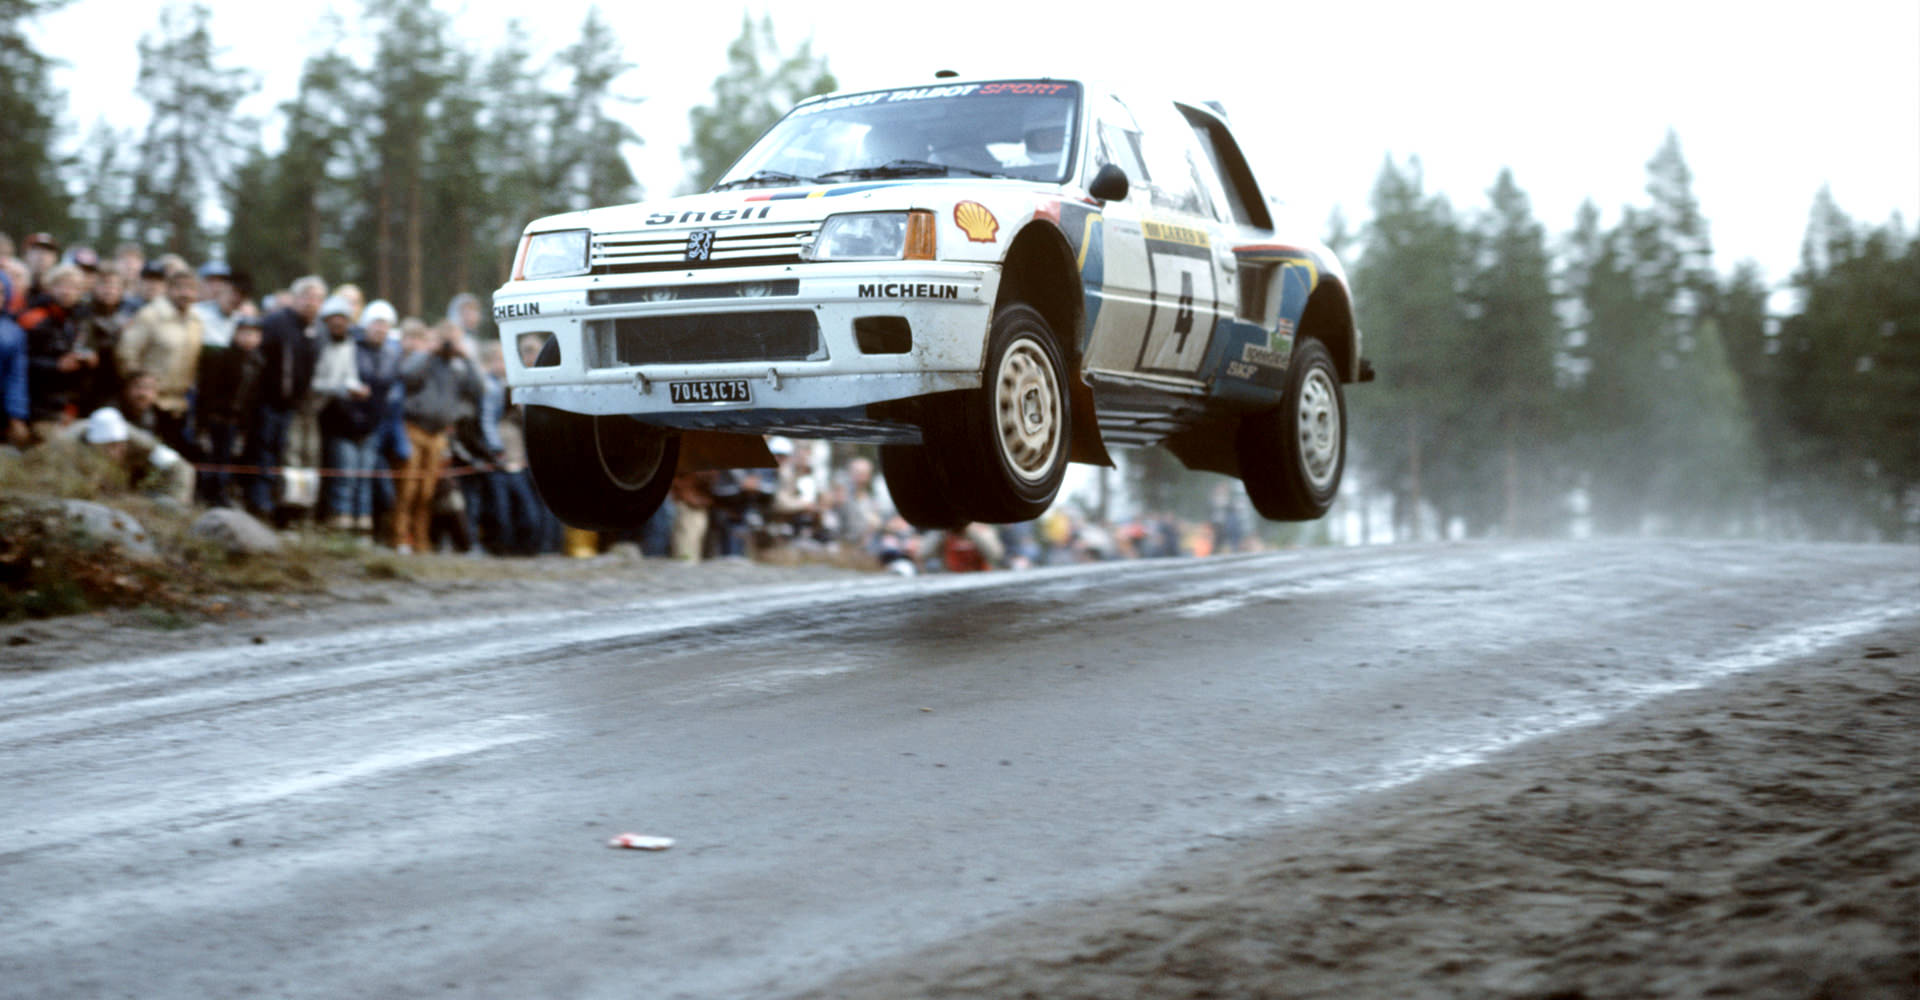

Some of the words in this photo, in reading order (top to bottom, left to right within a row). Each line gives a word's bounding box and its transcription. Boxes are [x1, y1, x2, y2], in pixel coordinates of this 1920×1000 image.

[979, 83, 1068, 95] SPORT
[645, 206, 771, 225] Shell
[858, 283, 959, 299] MICHELIN
[1174, 270, 1194, 354] 4
[672, 381, 747, 400] 704EXC75
